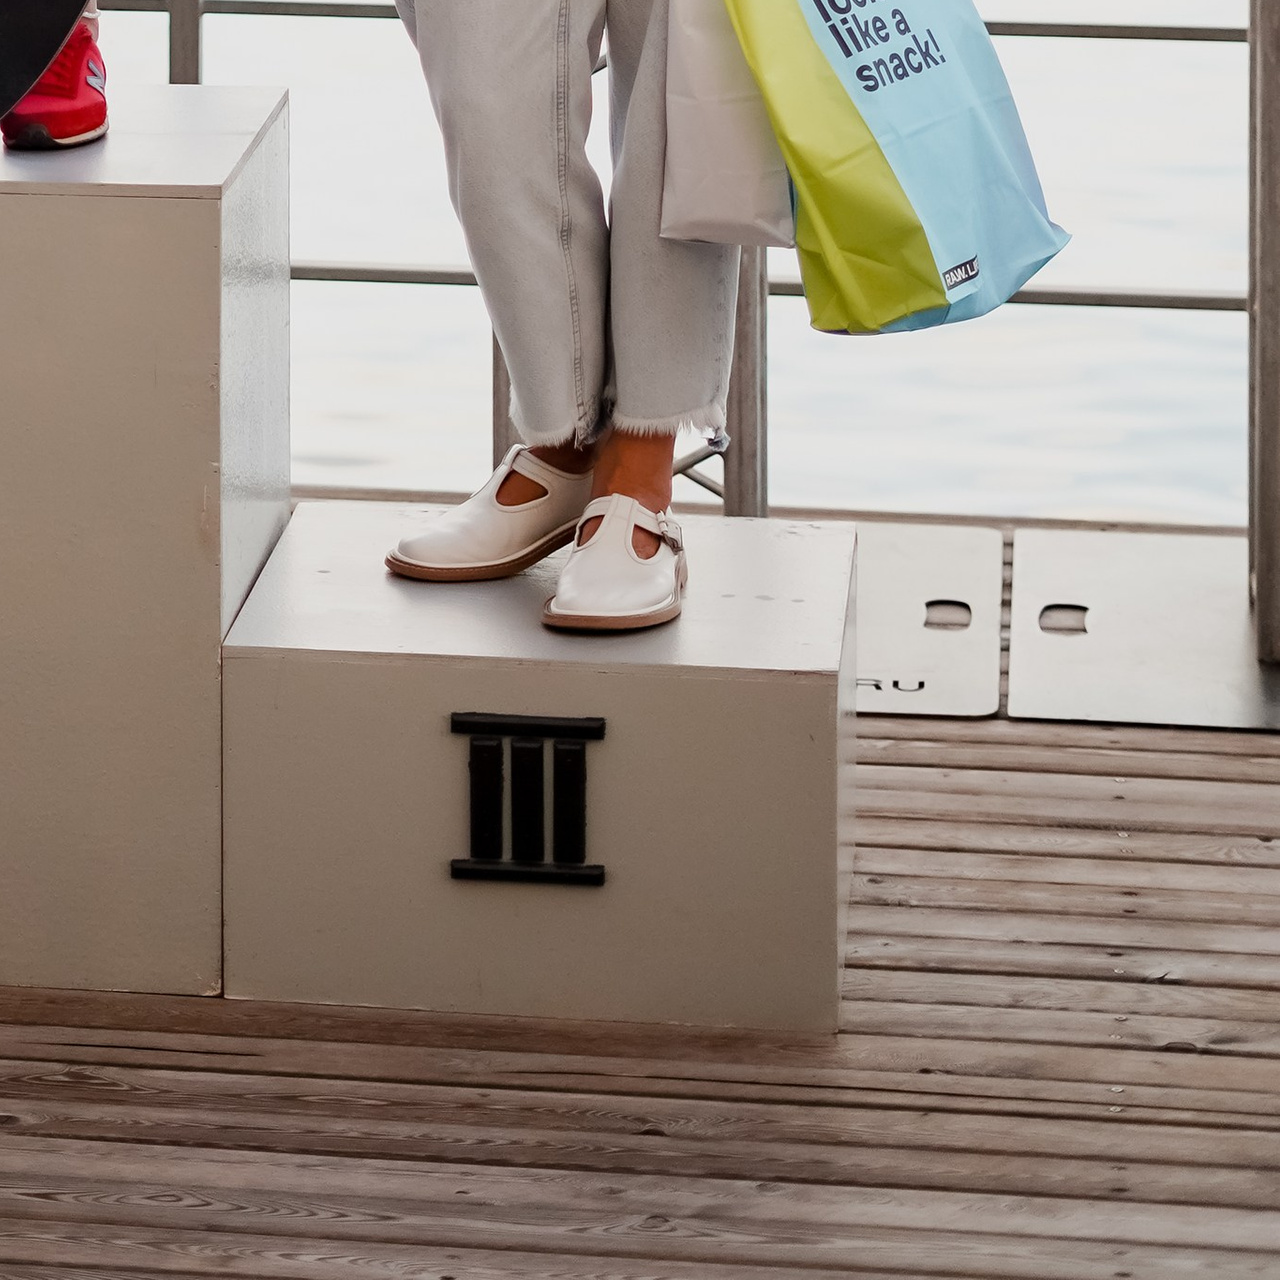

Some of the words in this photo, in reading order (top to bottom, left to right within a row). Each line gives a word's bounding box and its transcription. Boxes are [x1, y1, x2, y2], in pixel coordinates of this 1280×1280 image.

[827, 13, 890, 59] like
[891, 8, 912, 36] a
[855, 28, 947, 93] snack!
[449, 711, 606, 886] III
